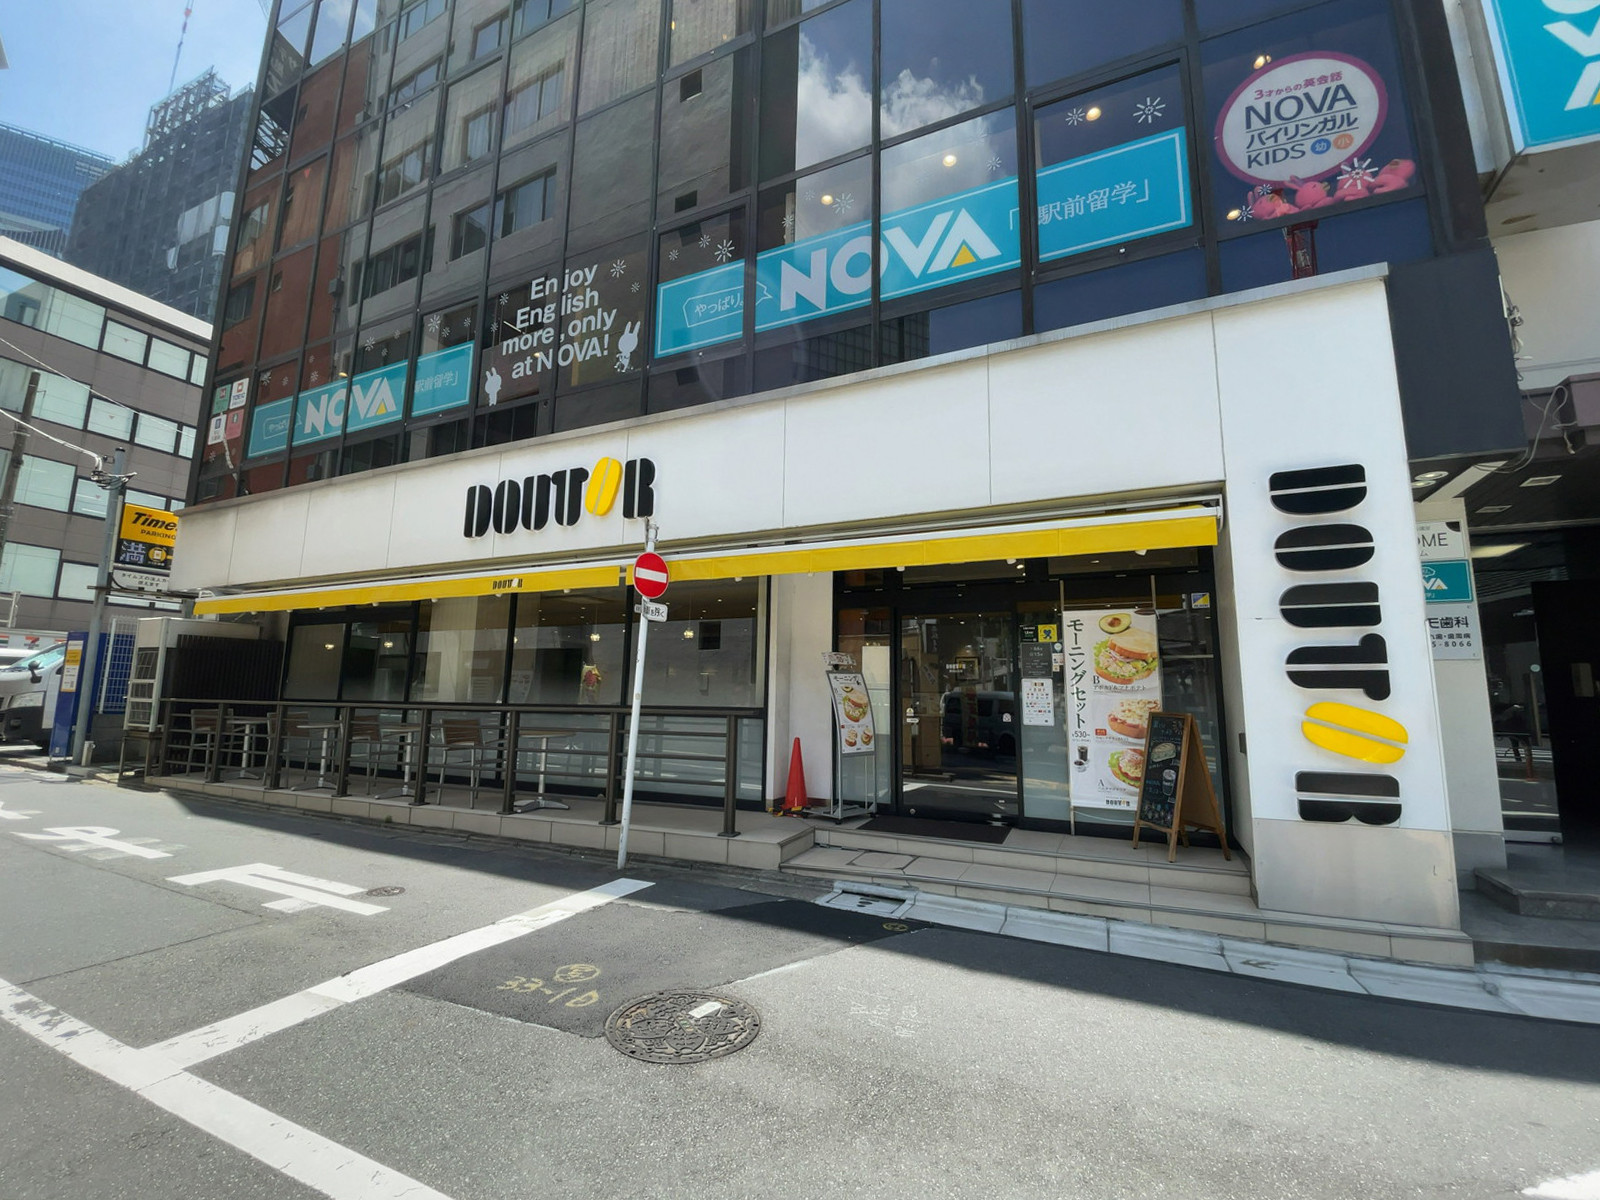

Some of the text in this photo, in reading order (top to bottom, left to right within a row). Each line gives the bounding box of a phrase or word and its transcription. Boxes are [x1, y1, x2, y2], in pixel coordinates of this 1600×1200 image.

[1254, 70, 1343, 100] 3才からの英会話
[1245, 84, 1357, 130] NOVA
[1246, 113, 1358, 149] バイリンガル
[1247, 143, 1306, 169] KIDS
[780, 207, 1001, 312] NOVA
[511, 333, 609, 379] at NOVA!
[304, 377, 396, 435] NOVA
[463, 456, 656, 539] DOUTOR
[132, 511, 178, 531] Time
[120, 541, 147, 564] 満
[493, 578, 523, 590] DOUTOR
[1269, 463, 1409, 825] DOUTOR
[1066, 619, 1087, 729] モーニングセット
[1093, 675, 1101, 685] B
